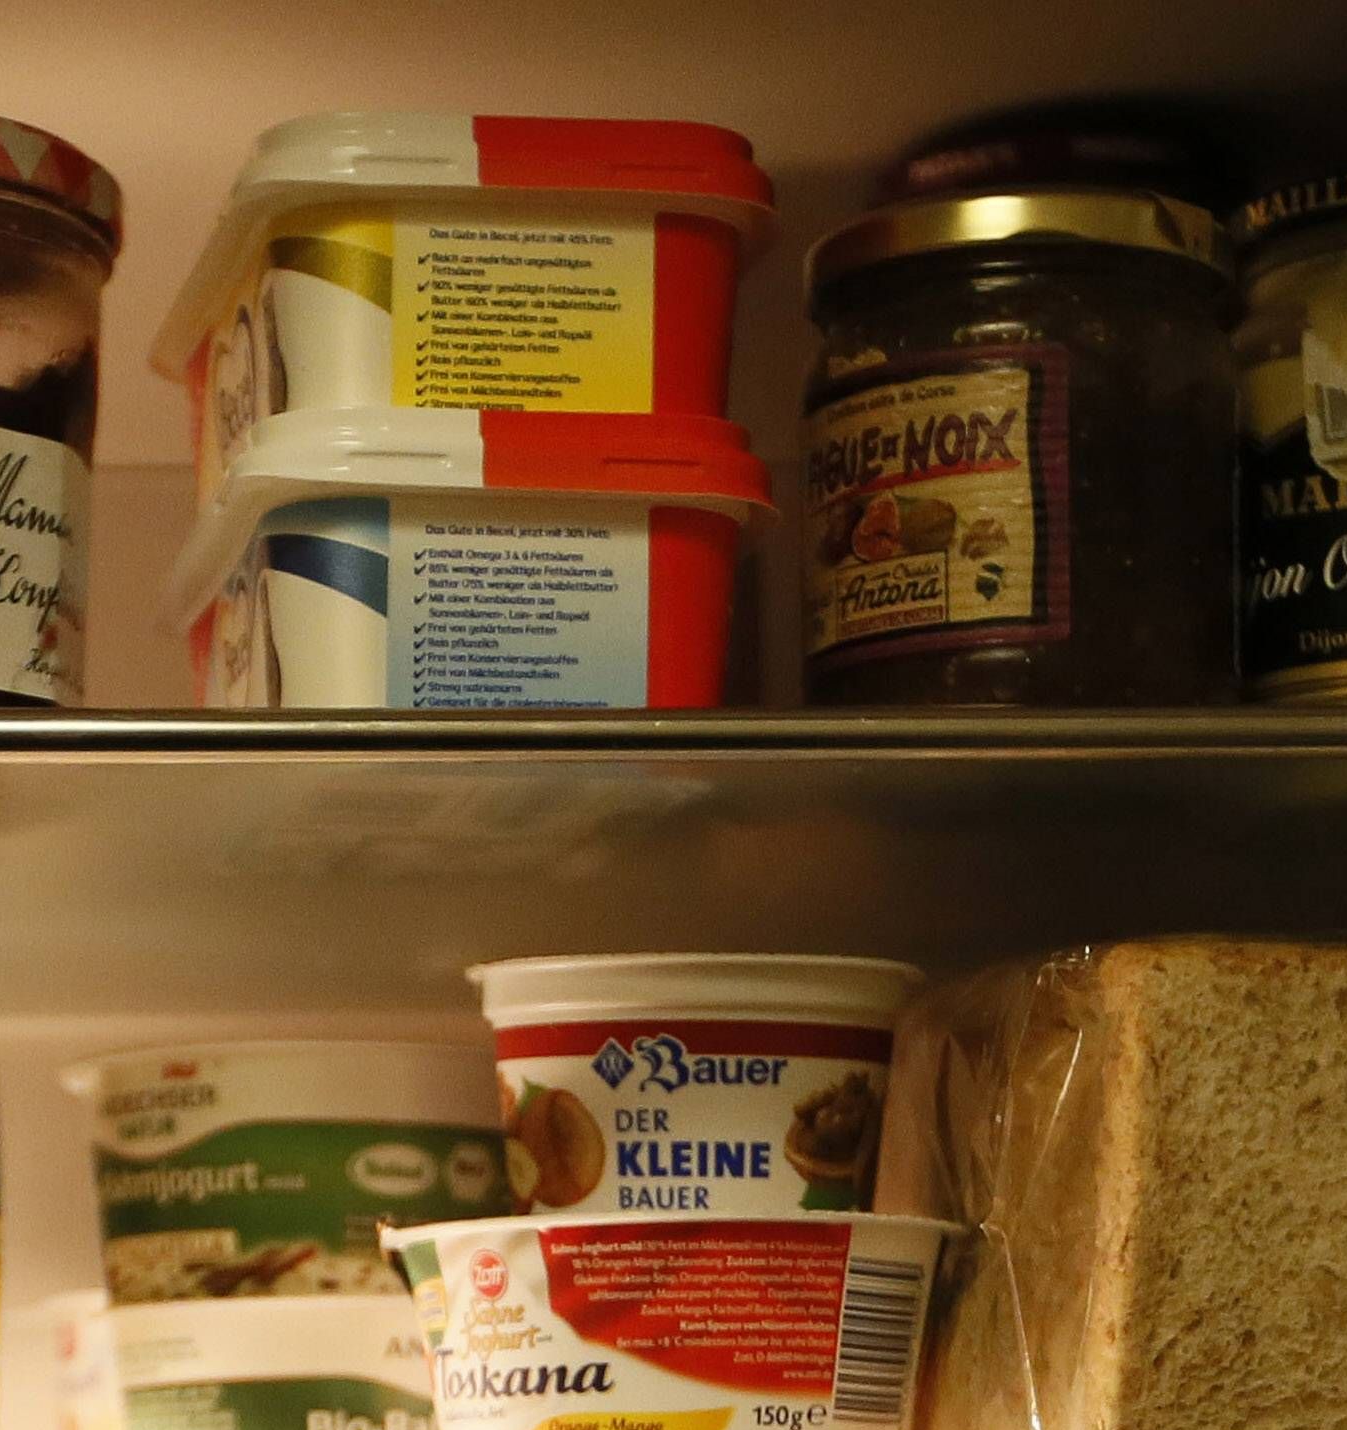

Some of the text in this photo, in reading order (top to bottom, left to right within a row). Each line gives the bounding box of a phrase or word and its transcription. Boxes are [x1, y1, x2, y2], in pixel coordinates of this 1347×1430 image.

[904, 408, 1021, 472] NOIX
[631, 1033, 789, 1093] Bauer
[614, 1108, 670, 1133] DER
[616, 1140, 772, 1179] KLEINE
[618, 1185, 709, 1211] BAUER
[435, 1350, 614, 1402] Toskana
